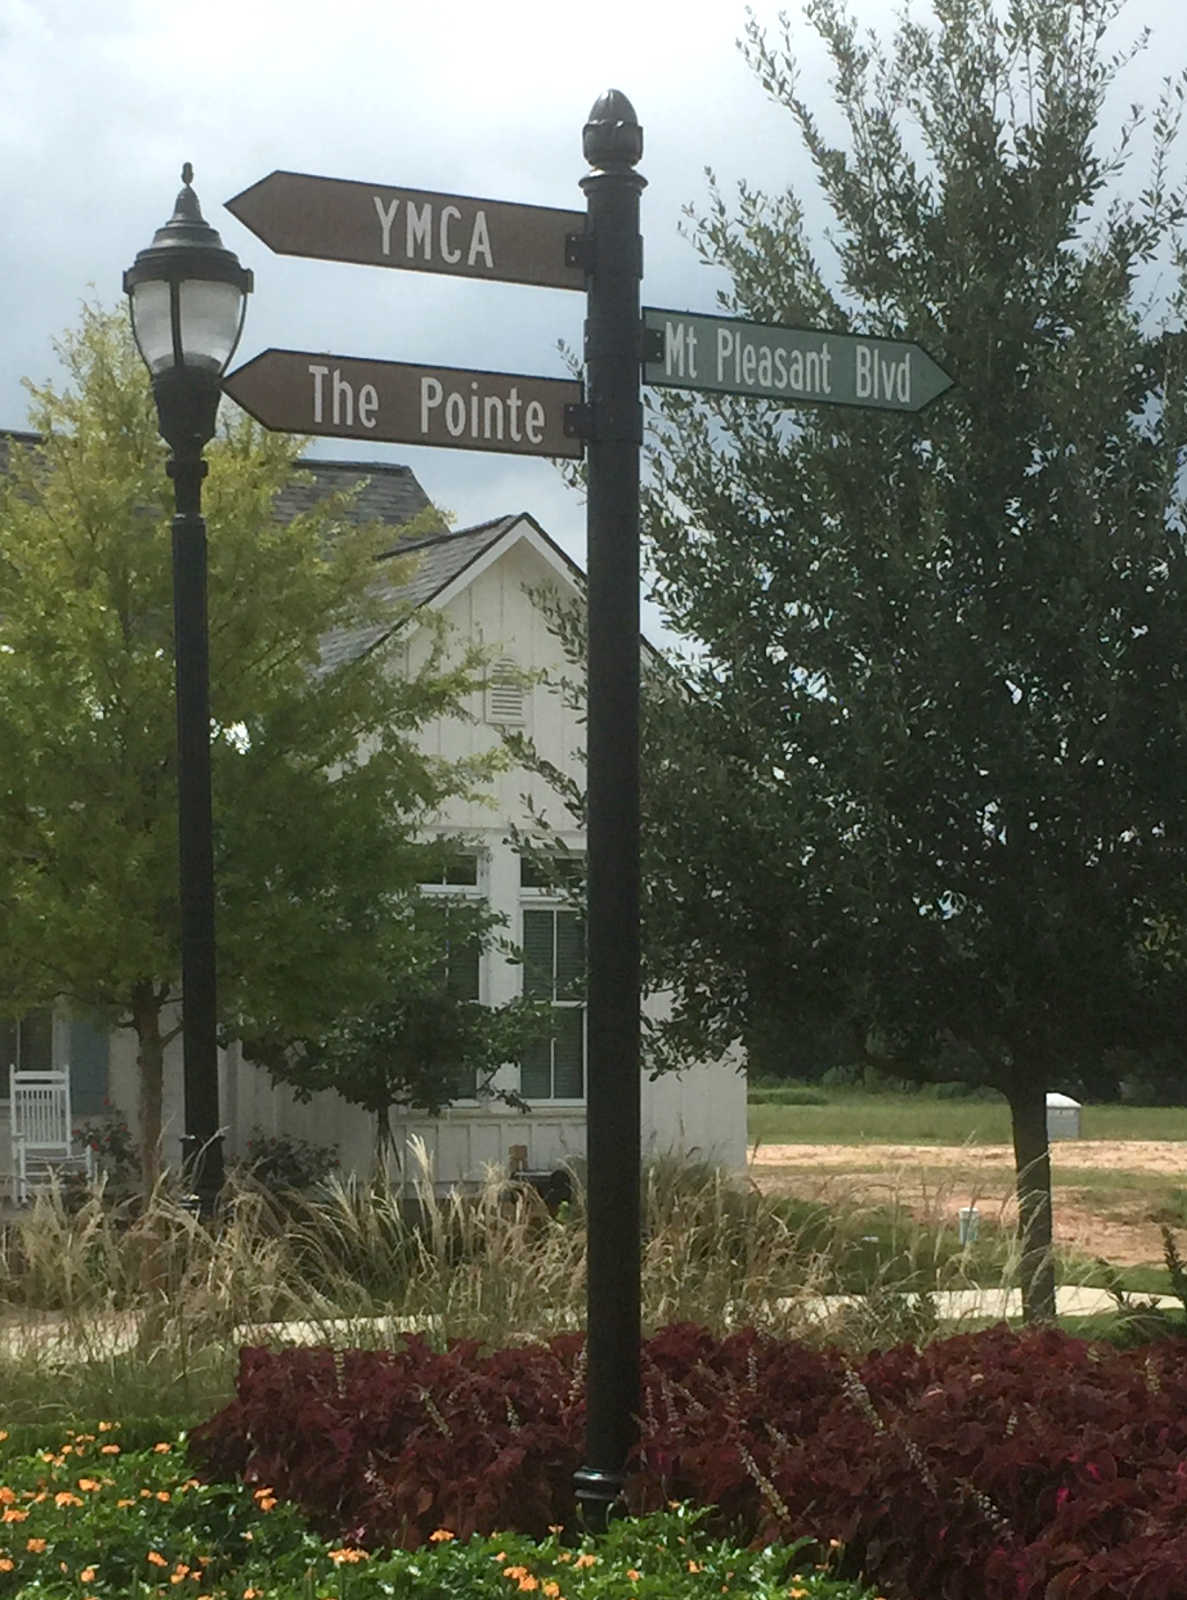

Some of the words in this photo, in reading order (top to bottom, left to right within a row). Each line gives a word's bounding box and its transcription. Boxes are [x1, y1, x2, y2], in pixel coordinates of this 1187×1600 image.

[373, 196, 494, 268] YMCA
[665, 321, 697, 379] Mt
[717, 327, 831, 394] Pleasant
[855, 344, 911, 402] Blvd
[308, 364, 379, 429] The
[420, 377, 545, 444] Pointe
